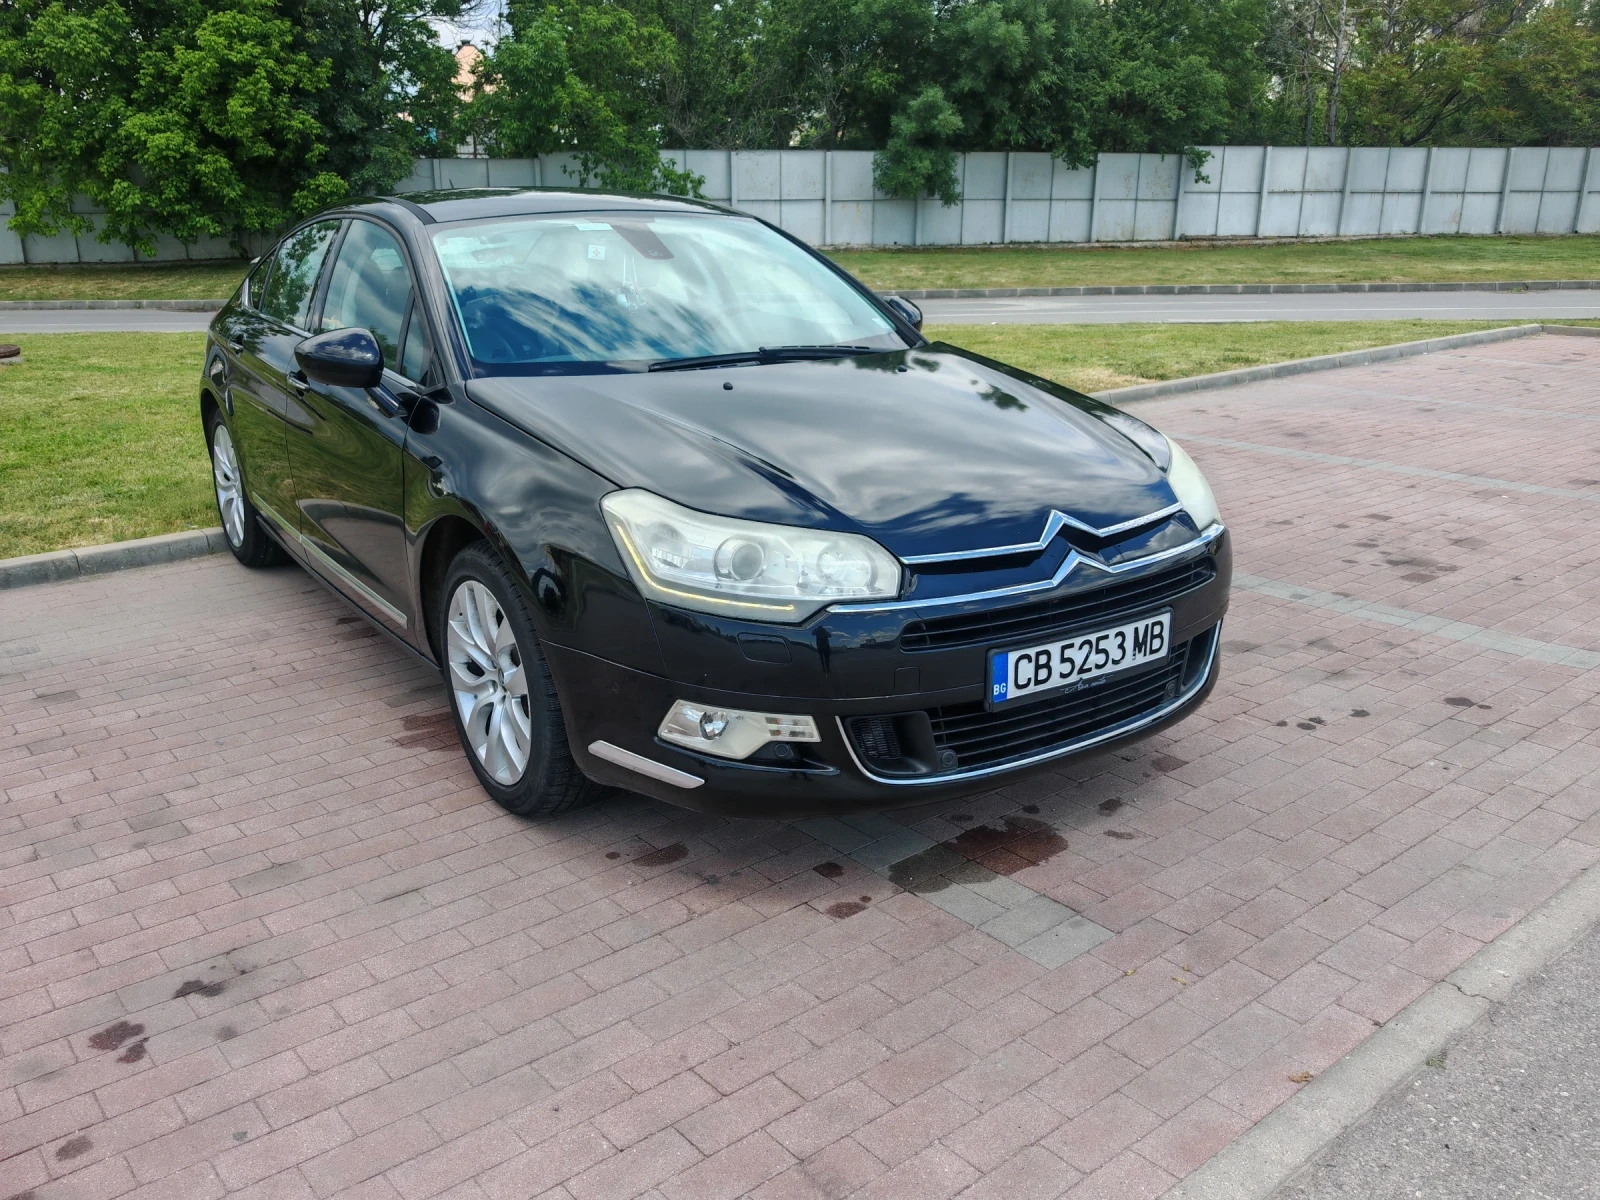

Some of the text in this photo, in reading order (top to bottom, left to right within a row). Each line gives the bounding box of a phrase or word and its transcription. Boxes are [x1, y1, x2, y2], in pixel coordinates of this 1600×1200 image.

[1013, 620, 1165, 690] CB 5253 MB
[993, 682, 1007, 696] BG
